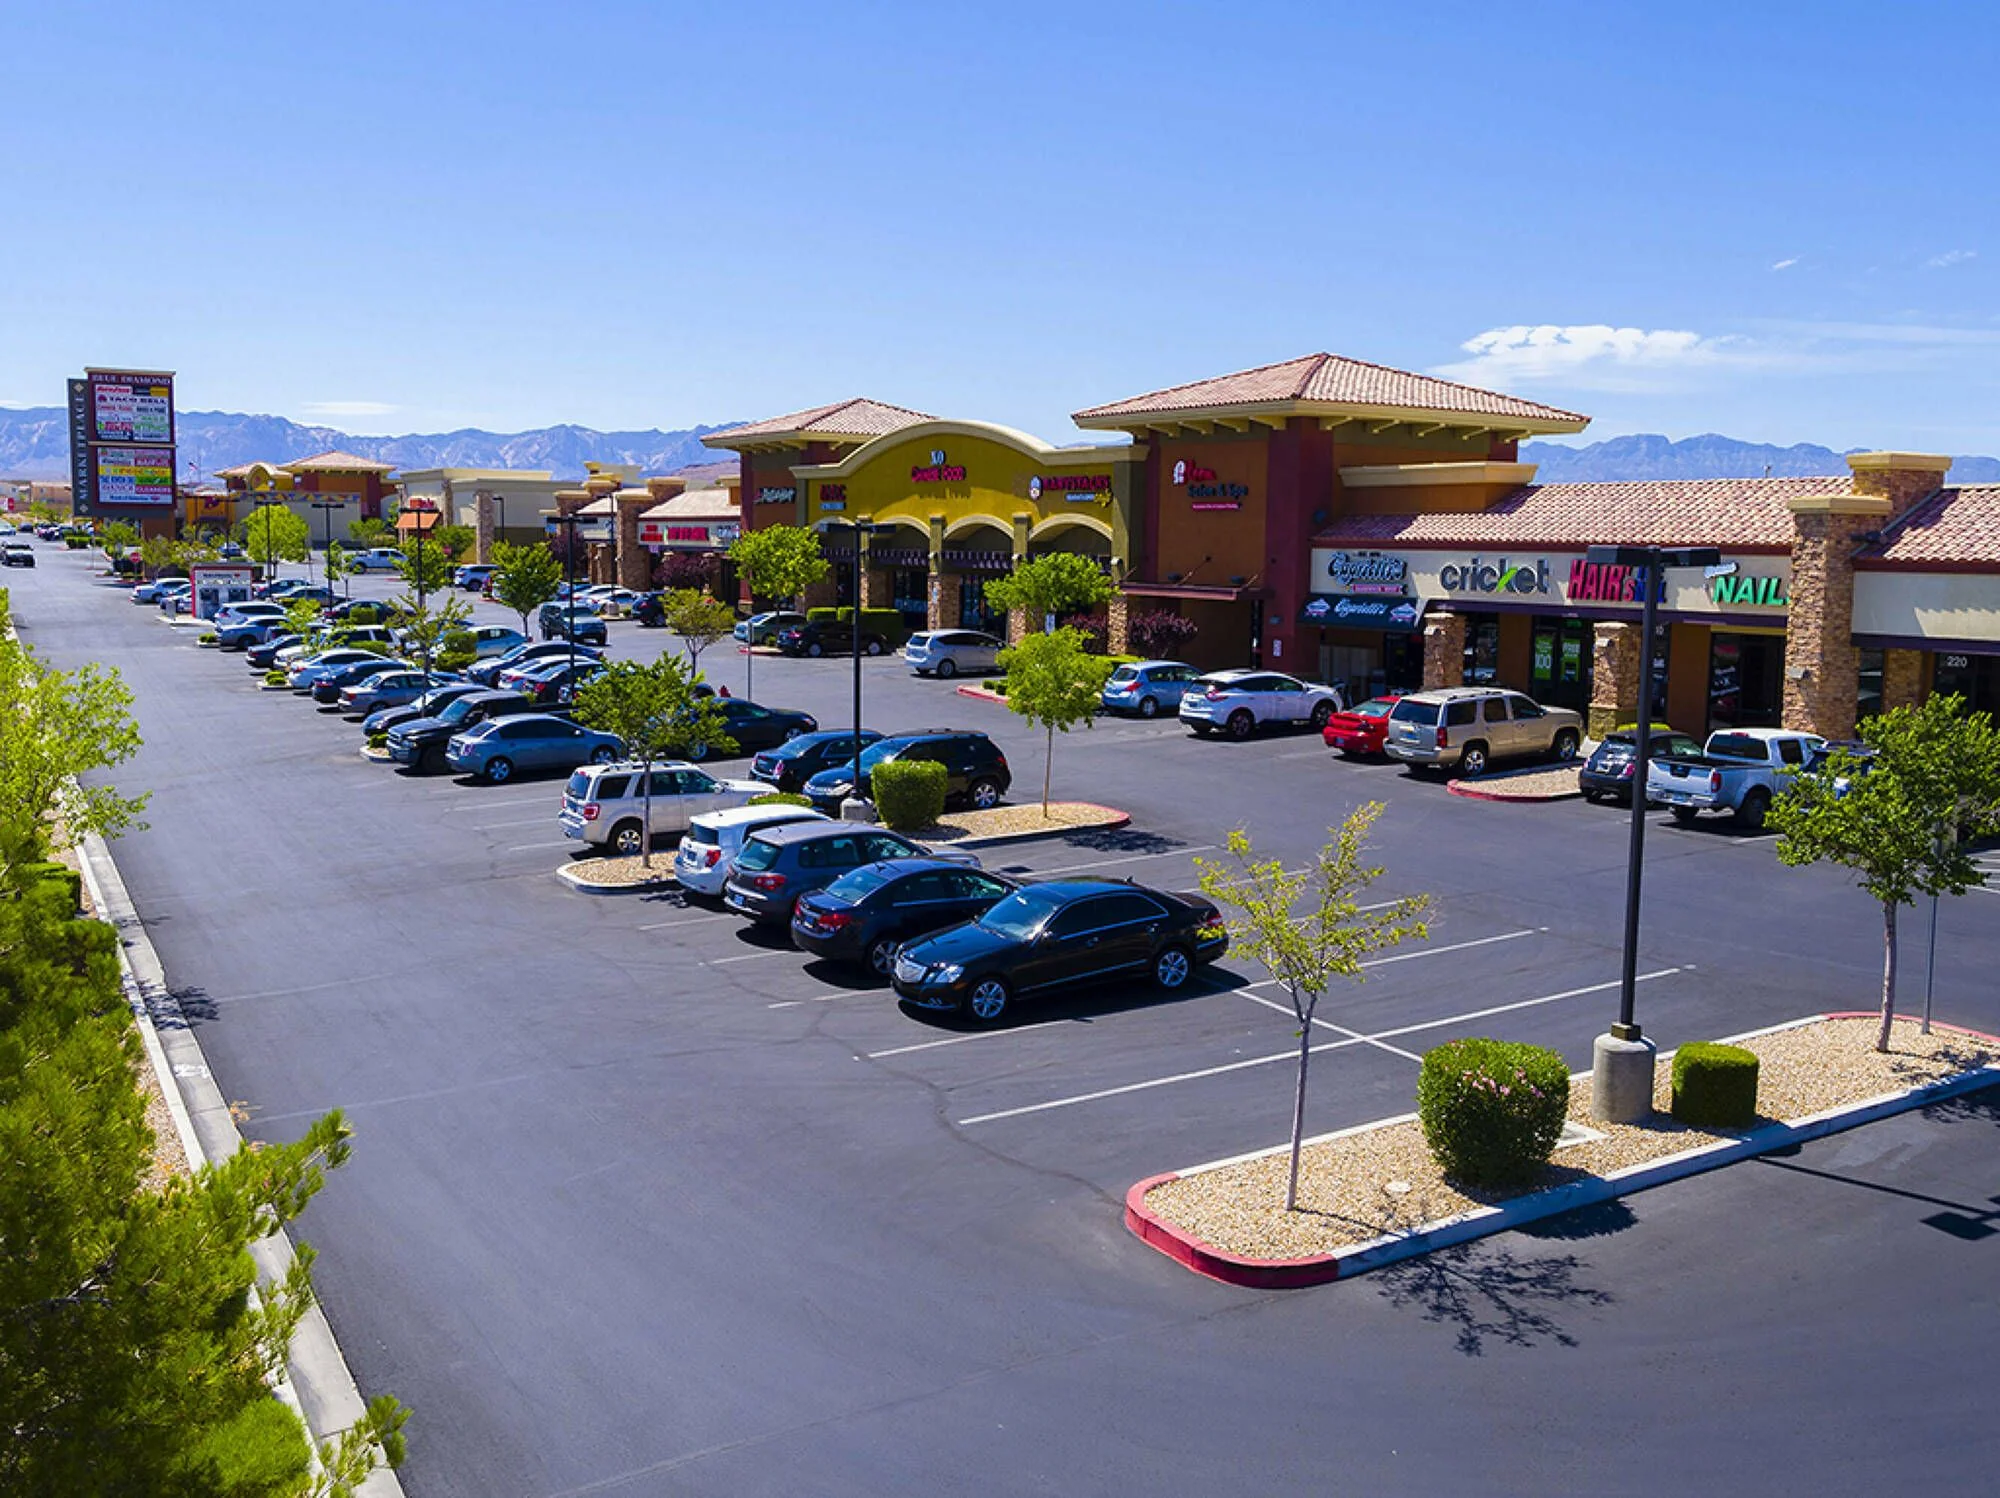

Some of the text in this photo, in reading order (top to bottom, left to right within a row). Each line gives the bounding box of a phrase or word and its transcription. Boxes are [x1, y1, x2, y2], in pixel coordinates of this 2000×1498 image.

[1440, 557, 1550, 594] cricket
[1713, 575, 1790, 606] NAIL
[1947, 656, 1967, 668] 220
